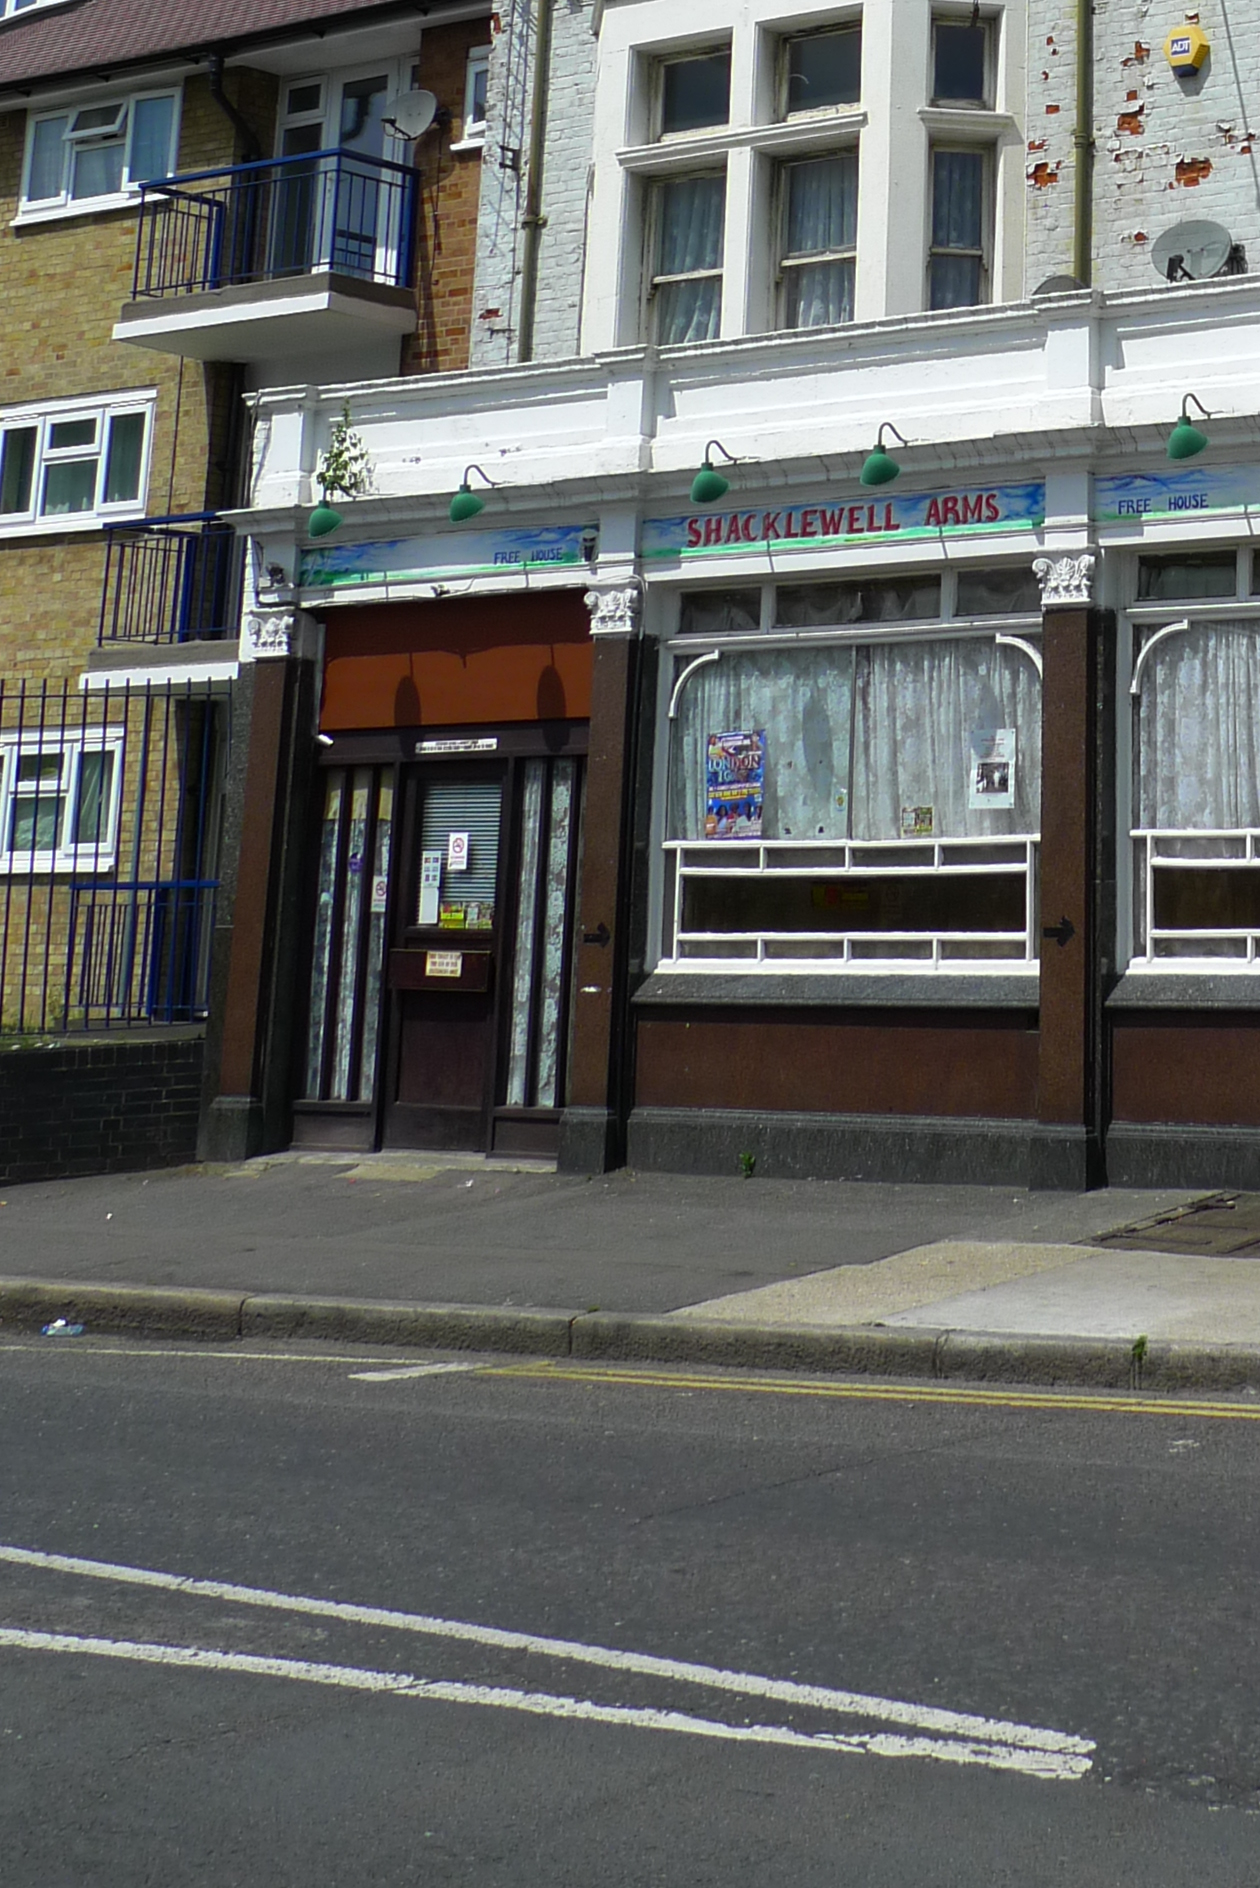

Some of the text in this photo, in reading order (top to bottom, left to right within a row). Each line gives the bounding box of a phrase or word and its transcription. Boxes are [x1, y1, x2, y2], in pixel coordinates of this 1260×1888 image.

[1171, 41, 1190, 51] ADT
[1118, 493, 1209, 515] FREE HOUSE
[687, 493, 1001, 547] SHACKLEWELL ARMS
[493, 547, 563, 565] FREE HOUSE
